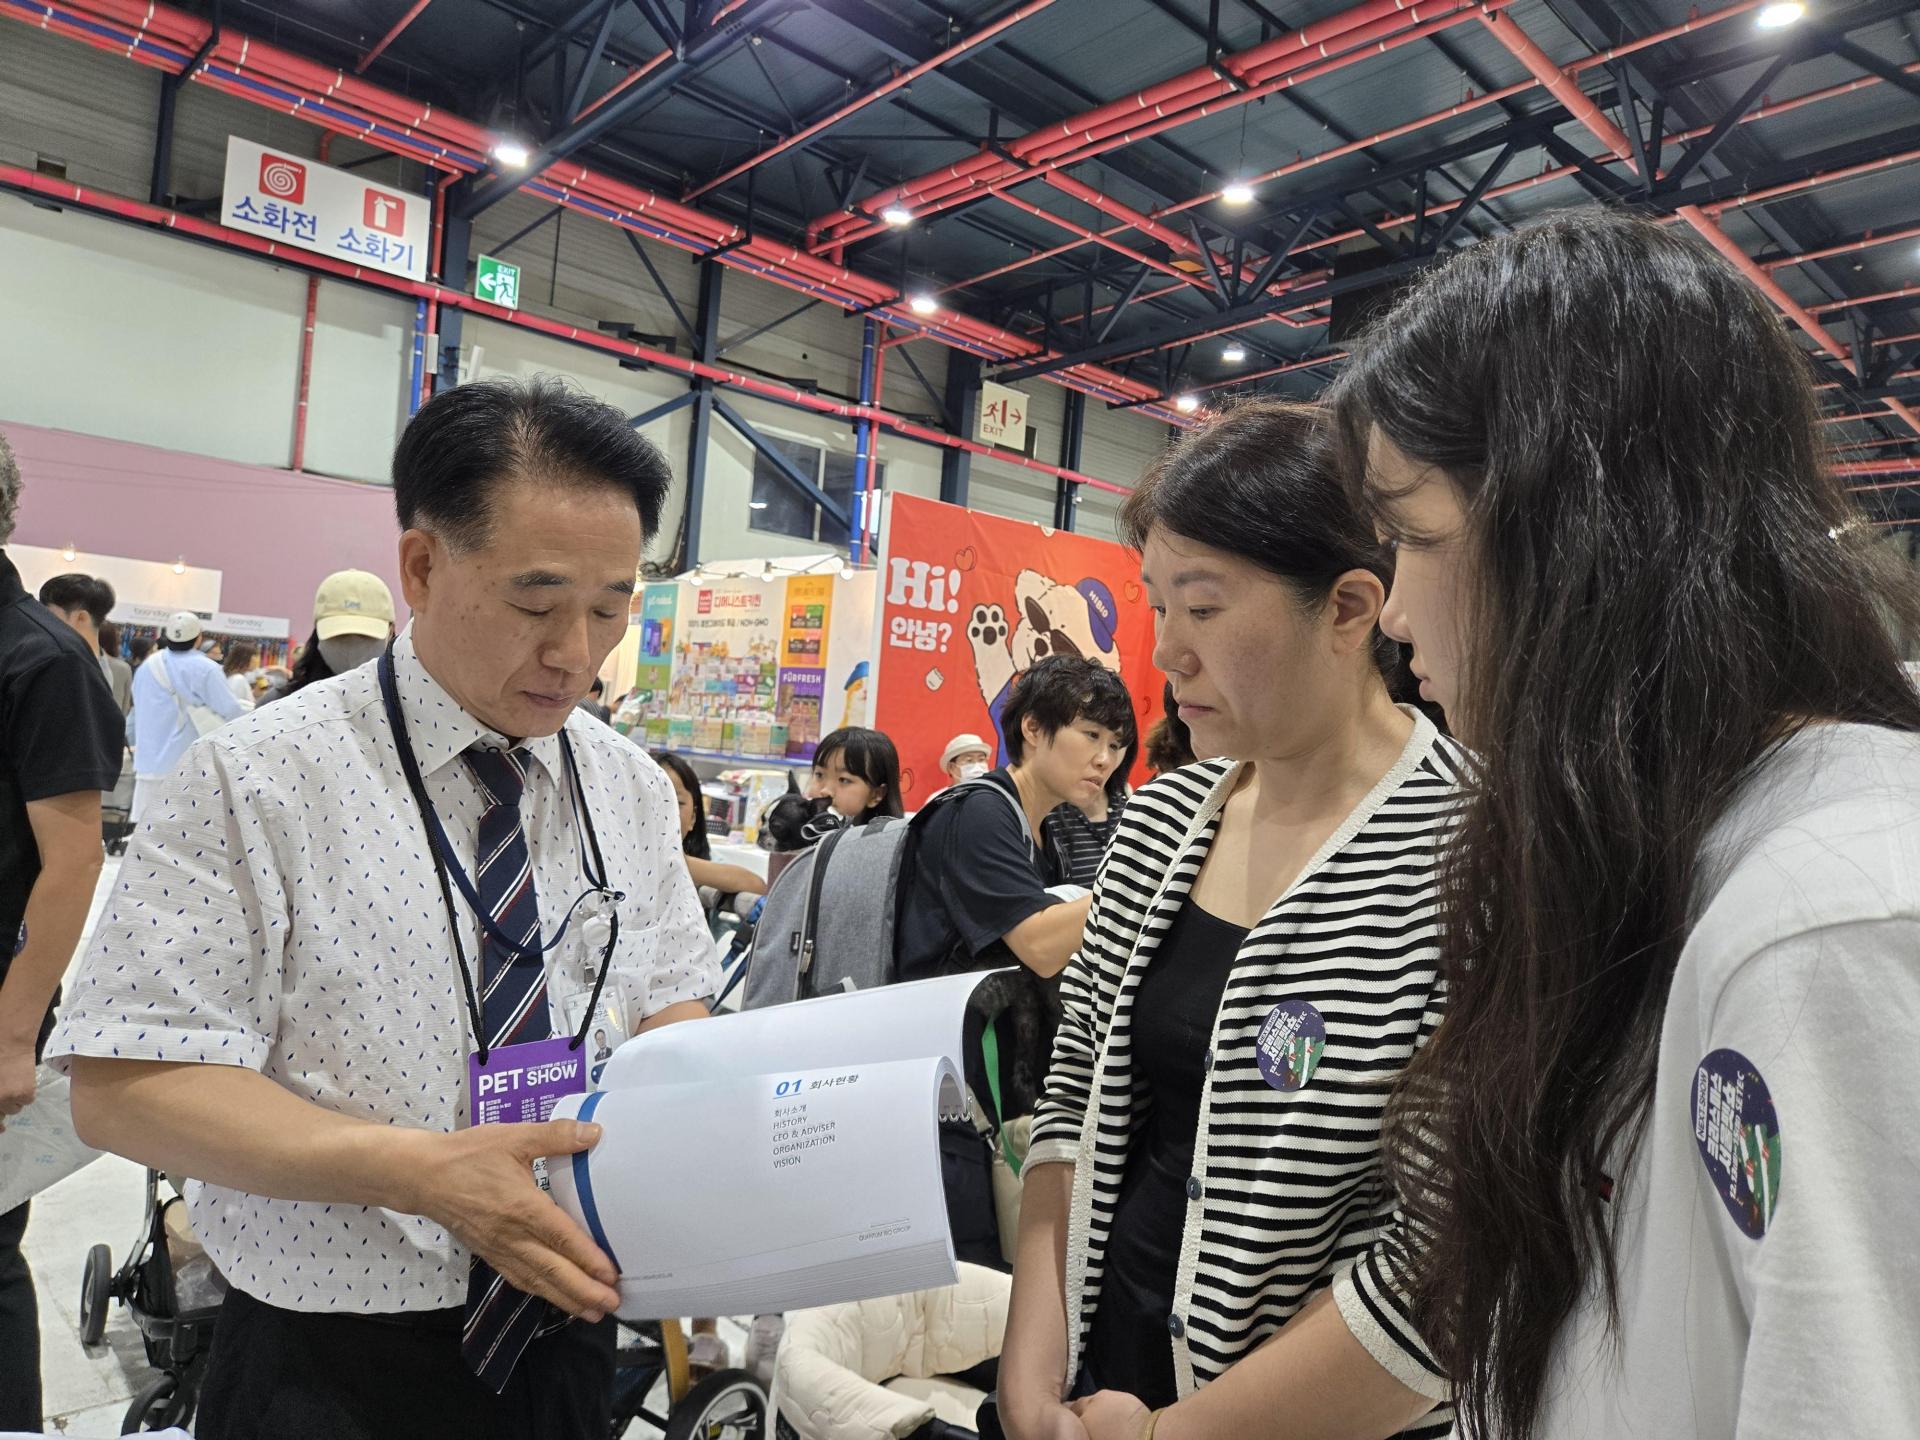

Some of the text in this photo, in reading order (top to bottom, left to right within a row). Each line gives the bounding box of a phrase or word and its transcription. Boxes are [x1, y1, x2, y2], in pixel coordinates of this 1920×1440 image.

[232, 196, 317, 242] 소화전
[337, 227, 413, 271] 소화기
[497, 264, 516, 277] EXIT
[983, 423, 1003, 437] EXIT
[887, 557, 961, 614] Hi!
[1088, 590, 1109, 618] HIBIO
[890, 616, 952, 653] 안녕?
[1293, 1011, 1308, 1032] SETEC
[479, 1068, 523, 1096] PET
[527, 1063, 577, 1086] SHOW
[775, 1074, 859, 1096] 01 회사현황
[1735, 1070, 1746, 1114] SETEC
[774, 1104, 807, 1118] 회사소개
[1697, 1073, 1708, 1139] NEXT SHOW
[773, 1116, 808, 1130] HISTORY
[773, 1121, 836, 1142] CEO & ADVISER
[773, 1135, 835, 1155] ORGANIZATION
[773, 1155, 801, 1169] VISION
